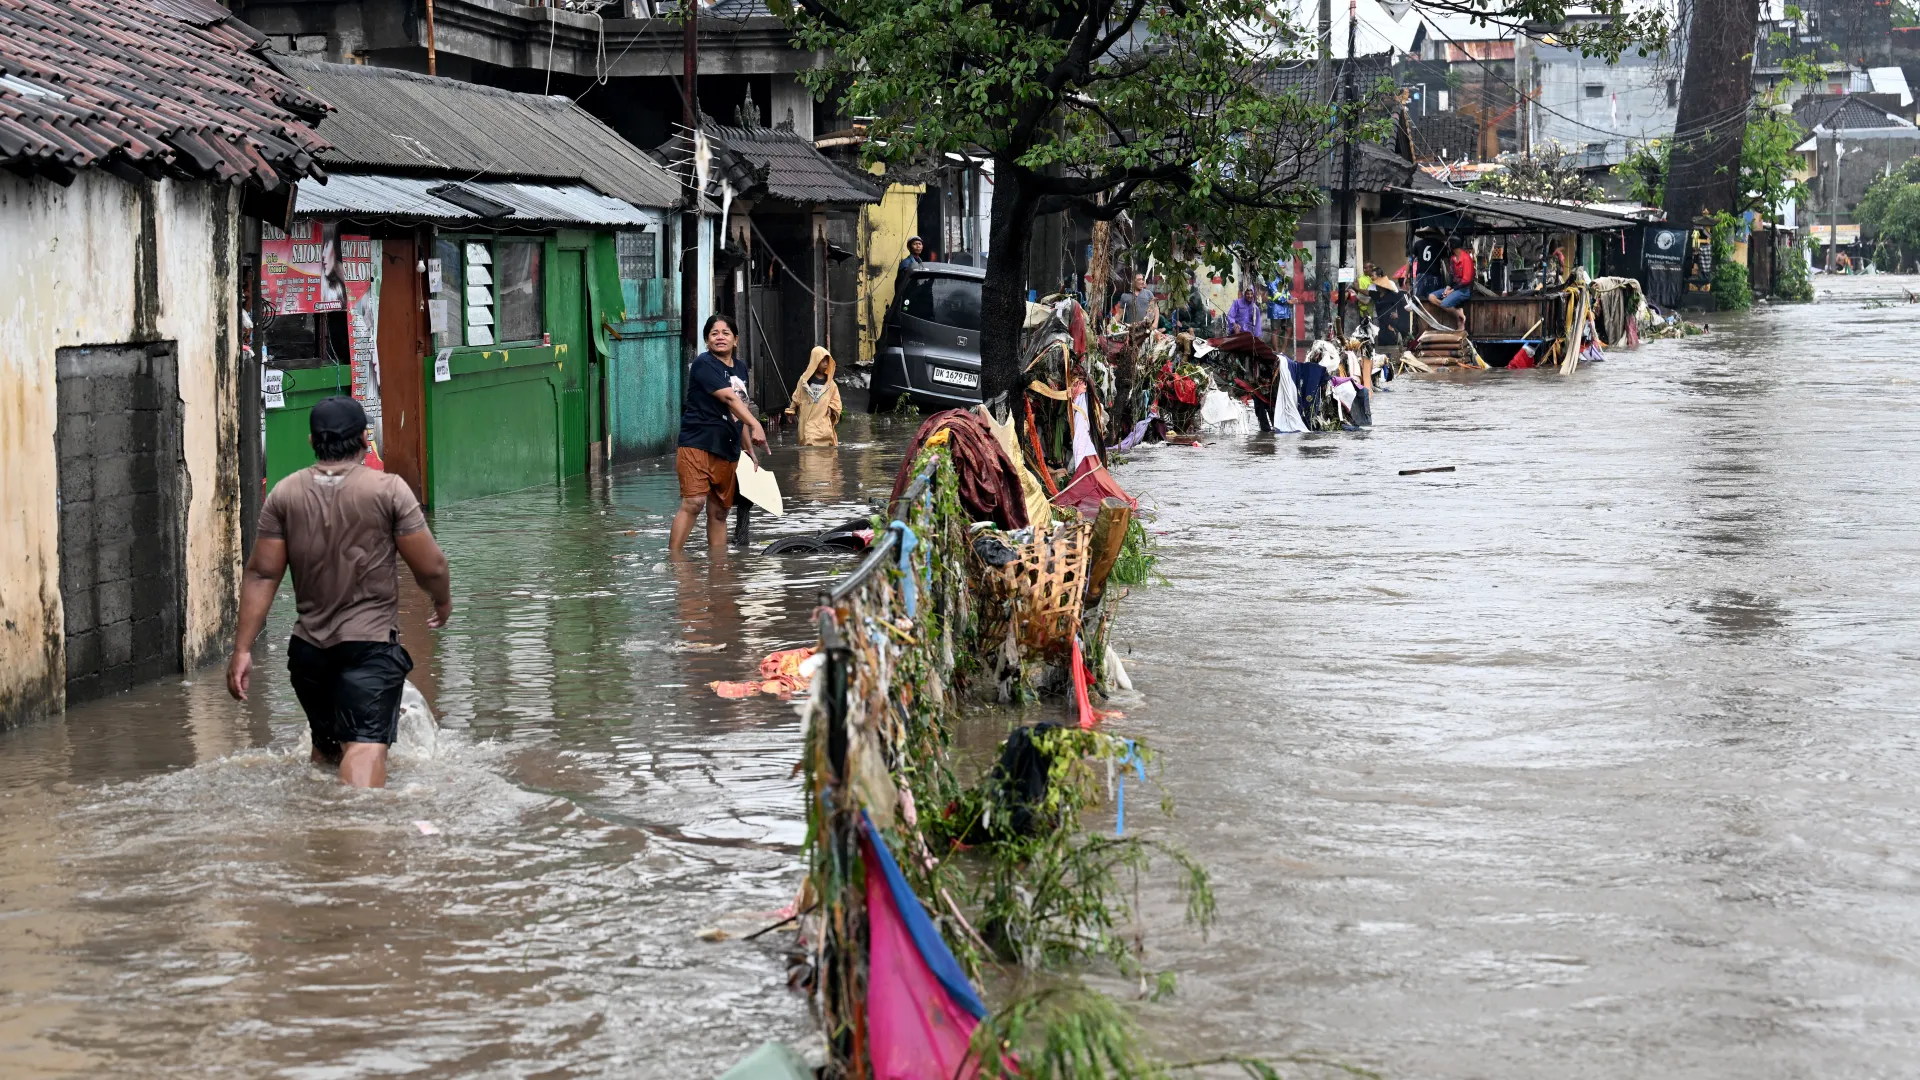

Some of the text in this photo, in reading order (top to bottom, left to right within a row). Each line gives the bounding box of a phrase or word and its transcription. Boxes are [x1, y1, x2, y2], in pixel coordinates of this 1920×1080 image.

[292, 244, 322, 263] SALON
[1423, 245, 1431, 261] 6
[342, 262, 371, 281] SALON
[935, 368, 944, 378] DK
[945, 370, 963, 381] 1679
[963, 373, 978, 383] FBN
